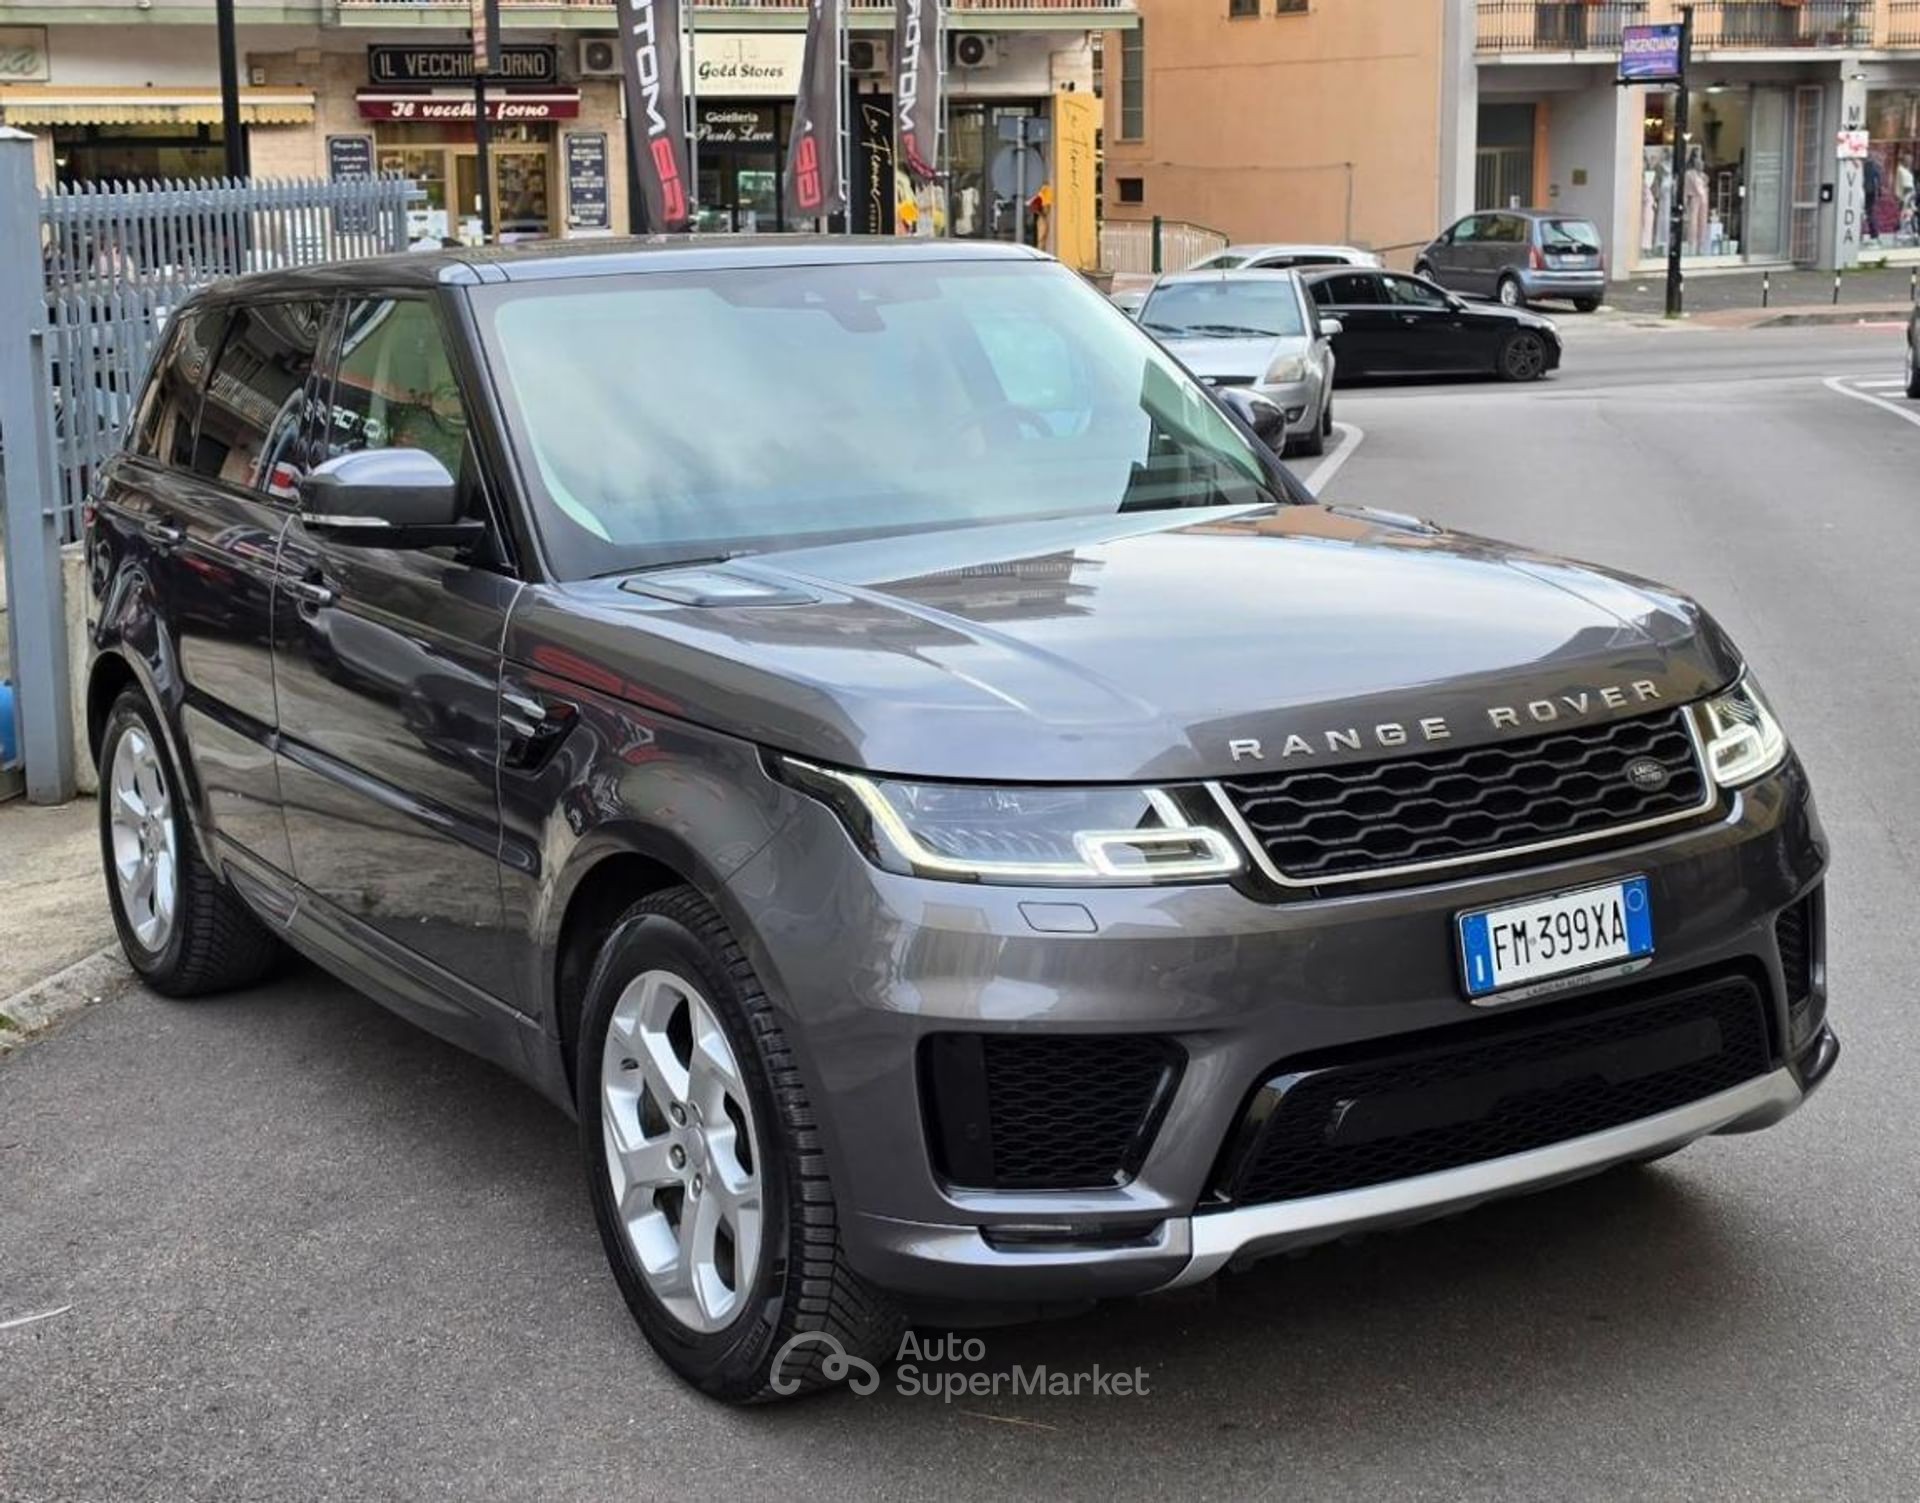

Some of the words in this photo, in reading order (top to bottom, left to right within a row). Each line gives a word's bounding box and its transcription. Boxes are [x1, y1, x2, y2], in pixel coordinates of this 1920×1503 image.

[379, 54, 397, 76] IL
[404, 53, 474, 76] VECCHI
[499, 53, 546, 76] ORNO
[698, 61, 737, 80] Gold
[740, 63, 784, 78] Stores
[391, 101, 415, 117] Il
[497, 102, 549, 120] forno
[705, 111, 759, 123] Gioielleria
[1843, 172, 1858, 245] VIDA
[1229, 716, 1452, 761] RANGE
[1487, 680, 1661, 728] ROVER
[1475, 955, 1485, 983] I
